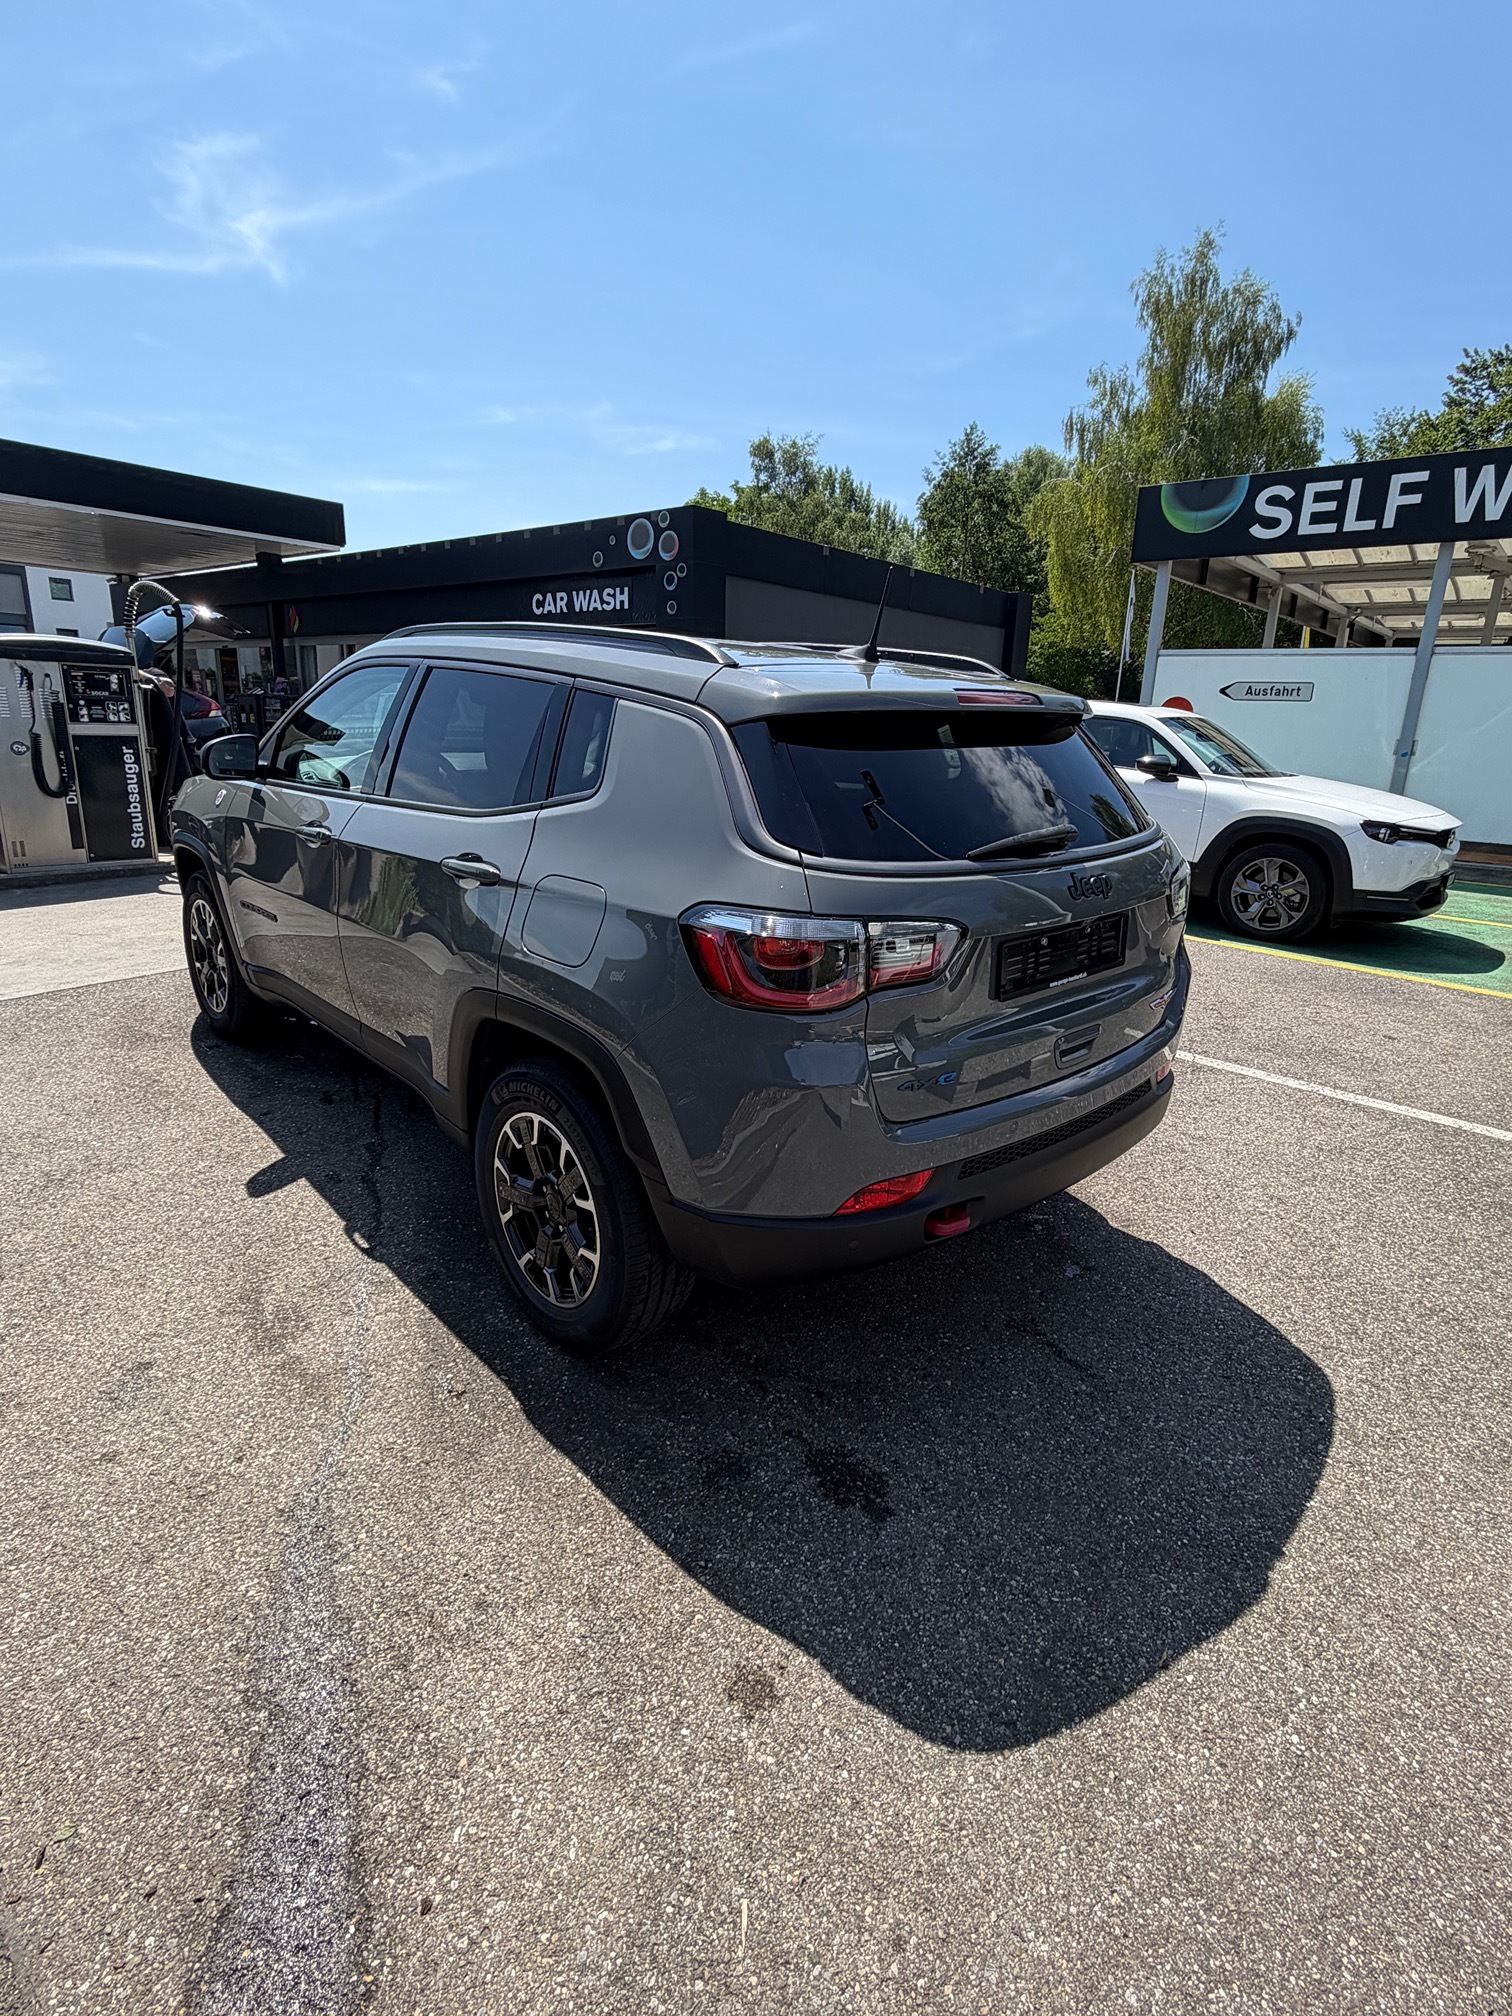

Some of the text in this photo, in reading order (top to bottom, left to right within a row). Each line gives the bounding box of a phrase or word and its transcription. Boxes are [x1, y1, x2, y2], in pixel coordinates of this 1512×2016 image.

[1249, 471, 1430, 540] SELF
[532, 587, 629, 615] CAR WASH
[1245, 685, 1302, 697] Ausfahrt
[122, 746, 146, 849] Staubsauger
[1067, 871, 1113, 901] Jeep
[508, 1081, 559, 1111] MICHELIN
